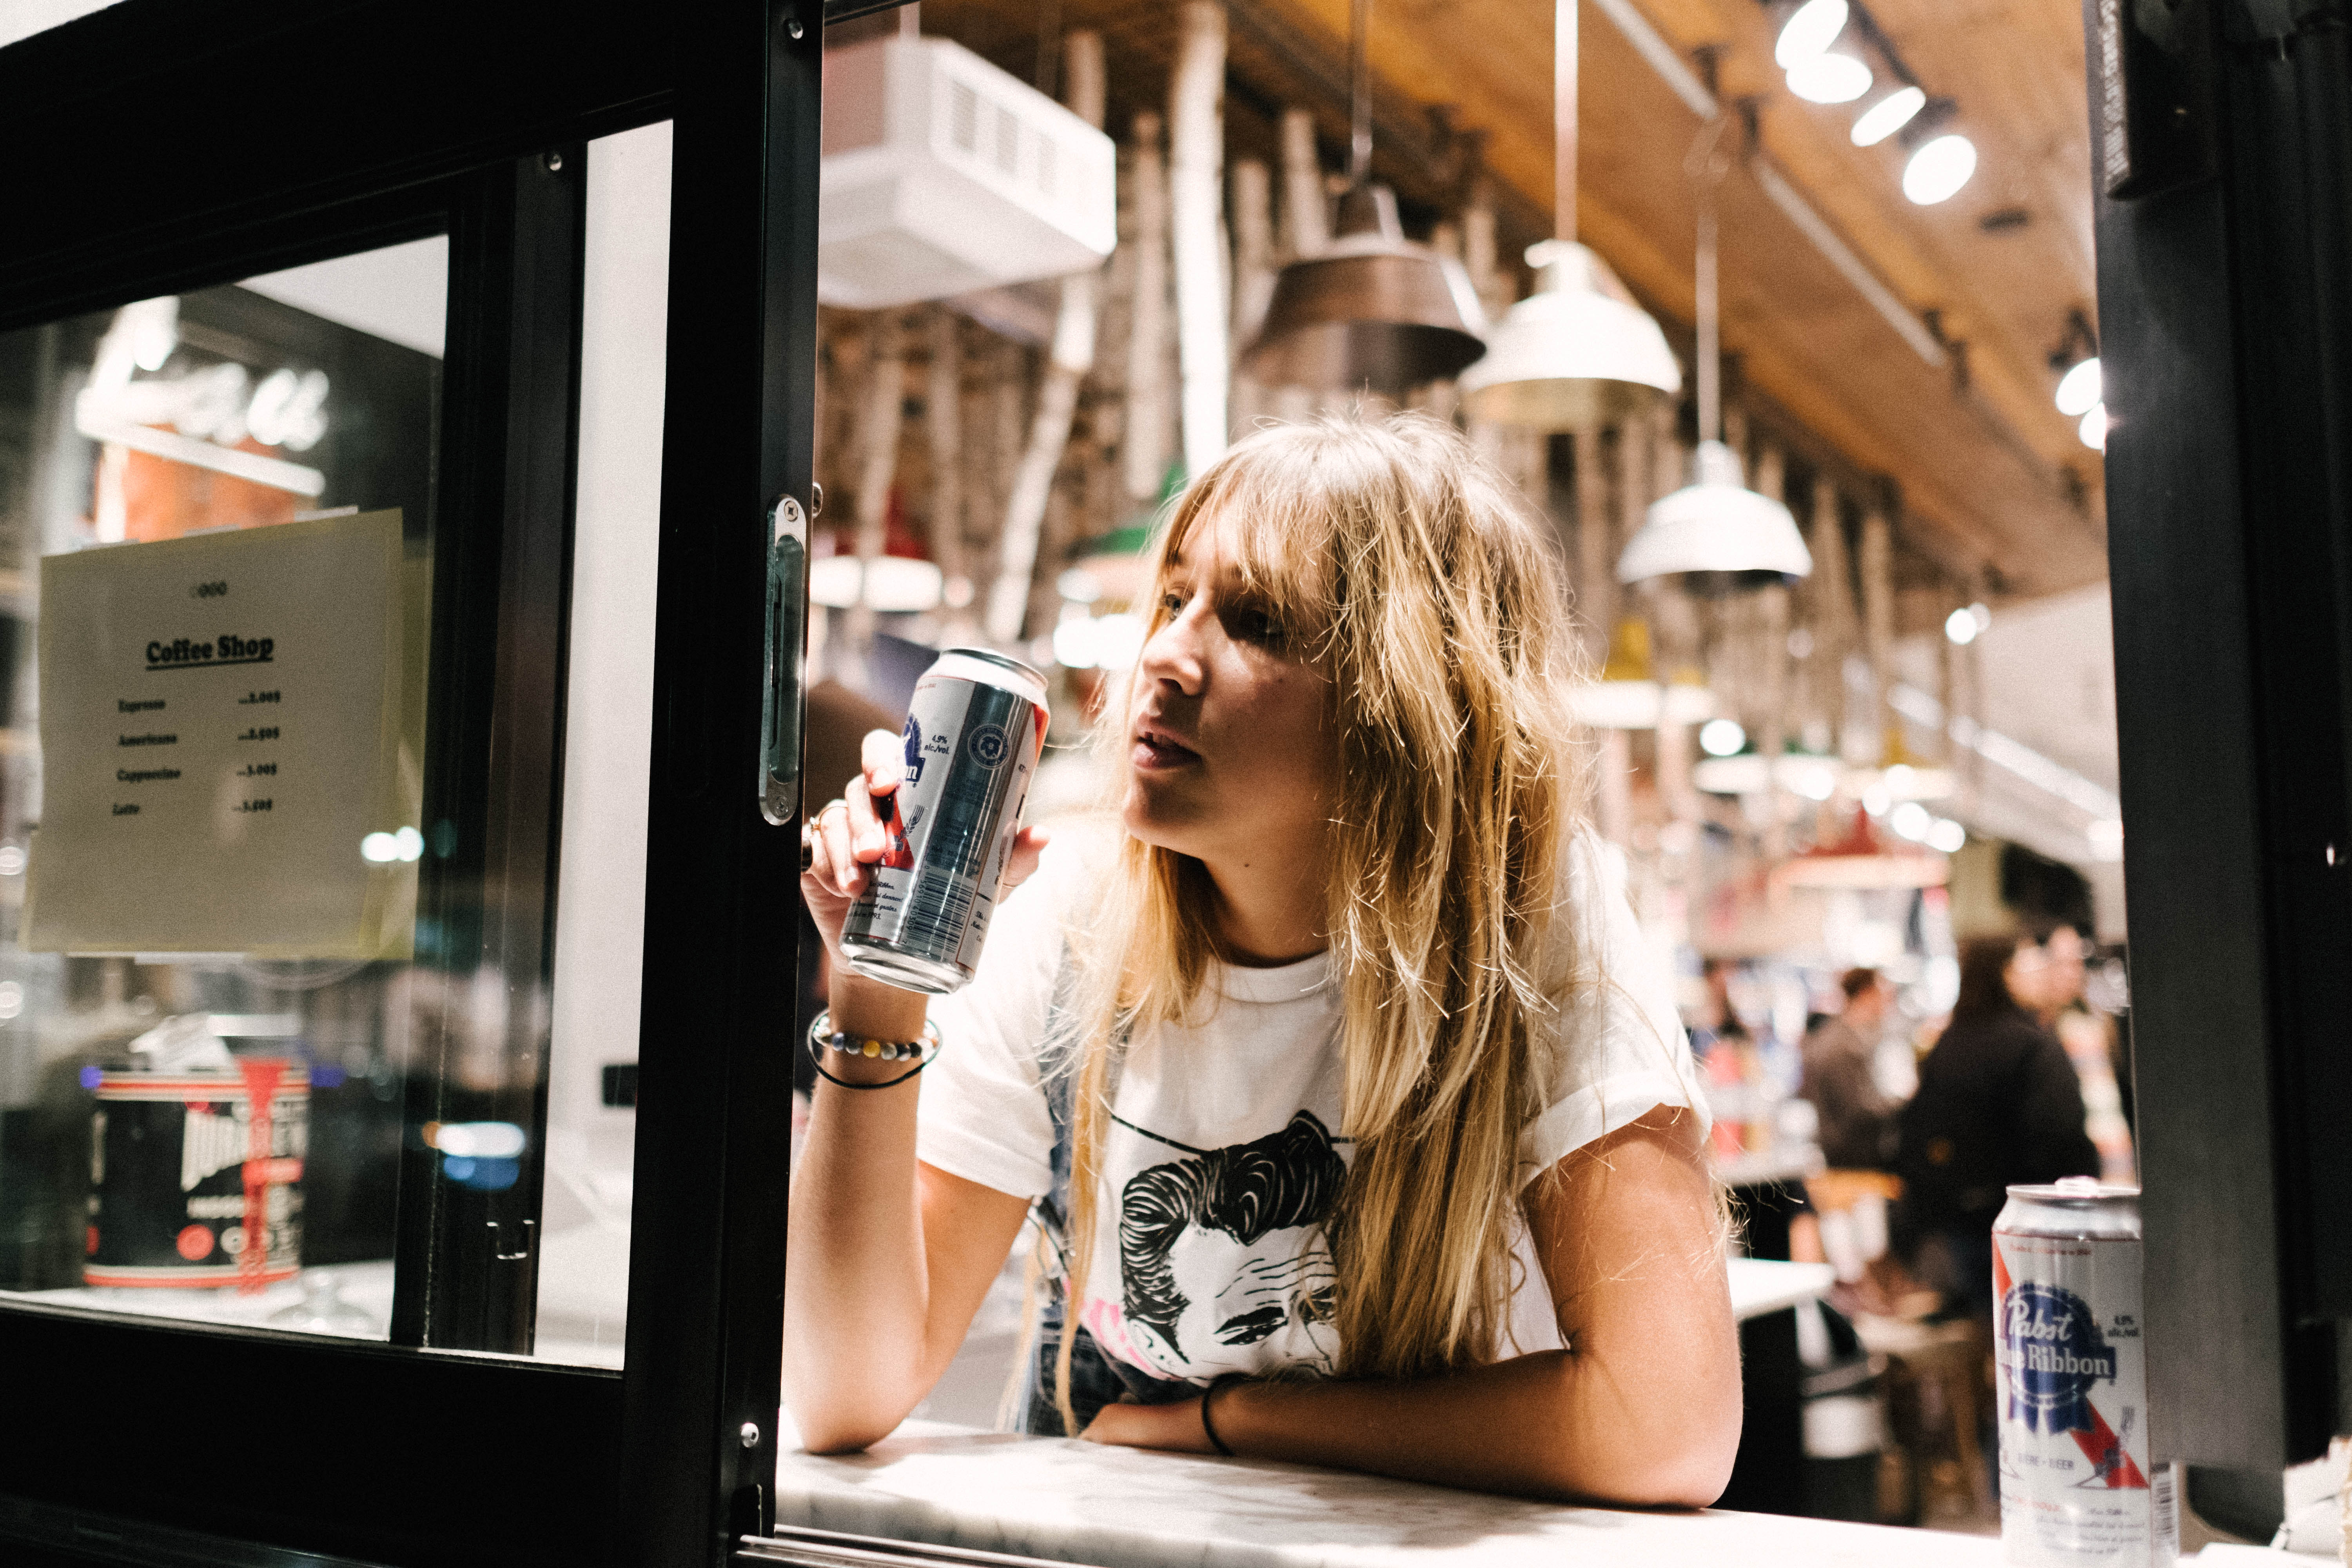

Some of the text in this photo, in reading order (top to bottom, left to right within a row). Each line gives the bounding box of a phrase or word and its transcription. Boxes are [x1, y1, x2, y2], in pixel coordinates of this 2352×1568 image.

[147, 634, 274, 663] Coffee Shop
[932, 735, 947, 744] 4.9%
[2007, 1299, 2074, 1341] Pabst
[2027, 1343, 2109, 1375] Ribbon
